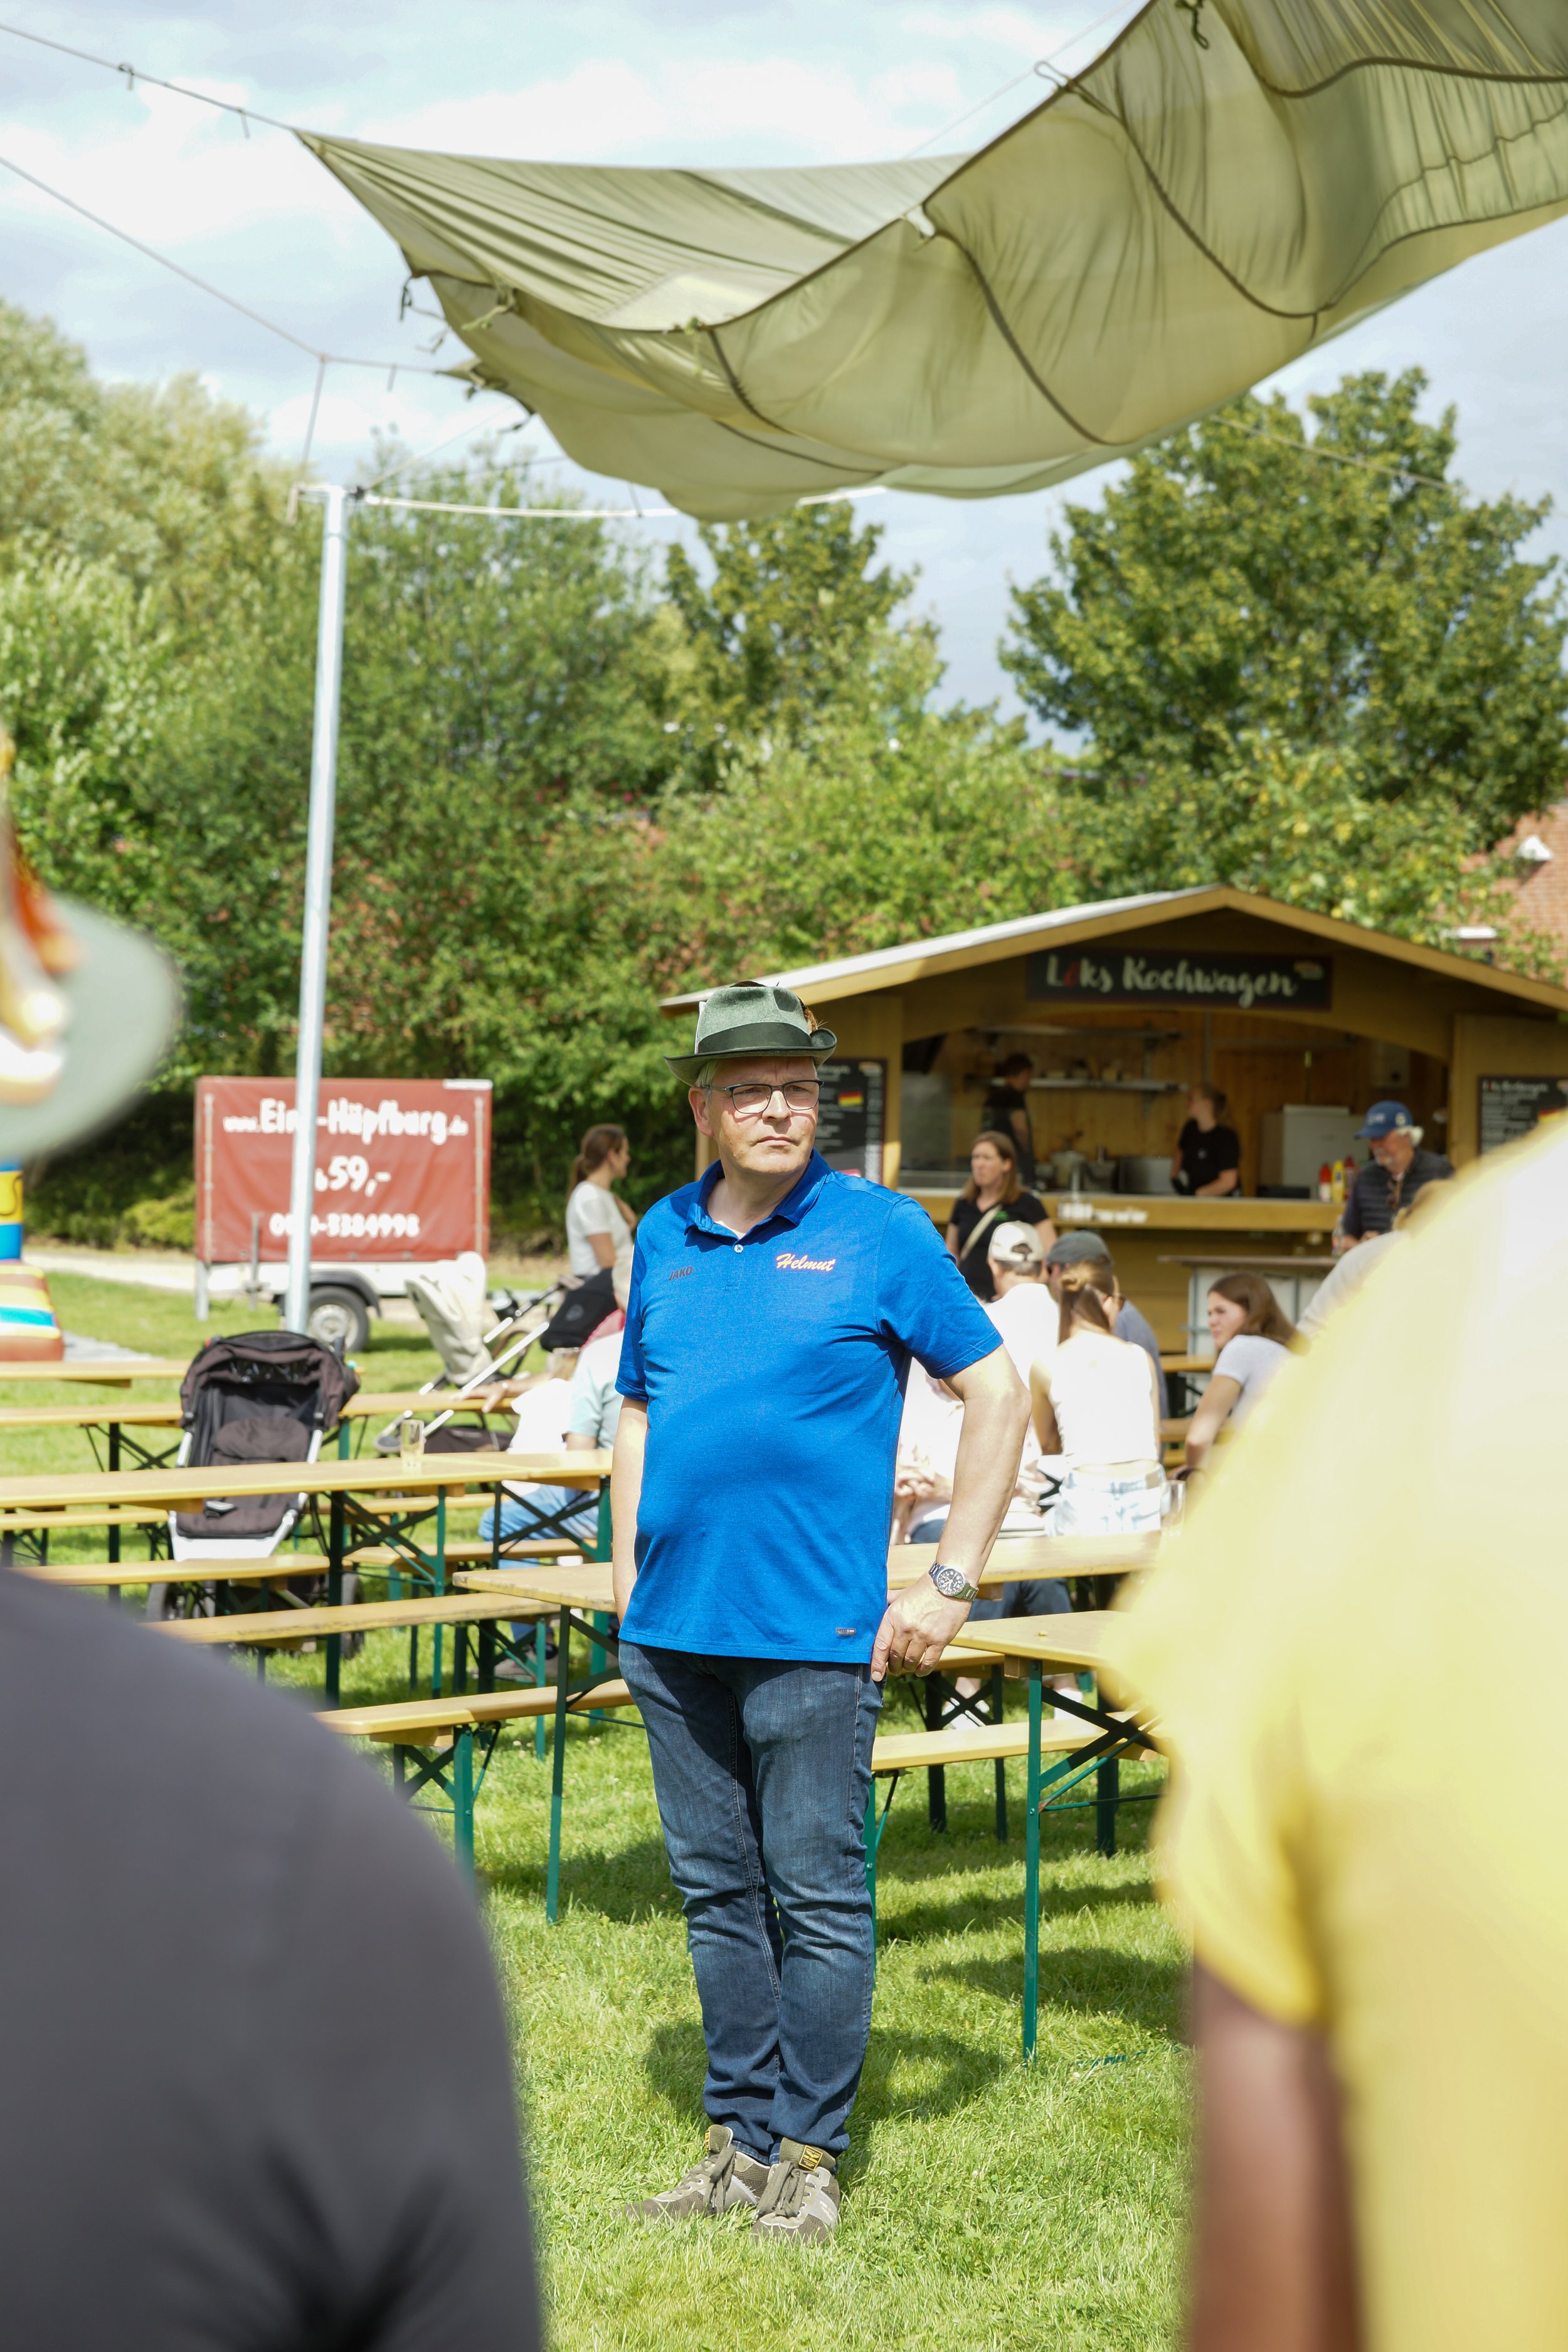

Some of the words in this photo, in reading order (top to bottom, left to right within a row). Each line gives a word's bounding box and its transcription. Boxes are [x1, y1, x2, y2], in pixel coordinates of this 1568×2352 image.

[1122, 955, 1299, 1008] Kochwagen
[775, 1253, 837, 1272] Helmut
[668, 1265, 694, 1281] JAKO
